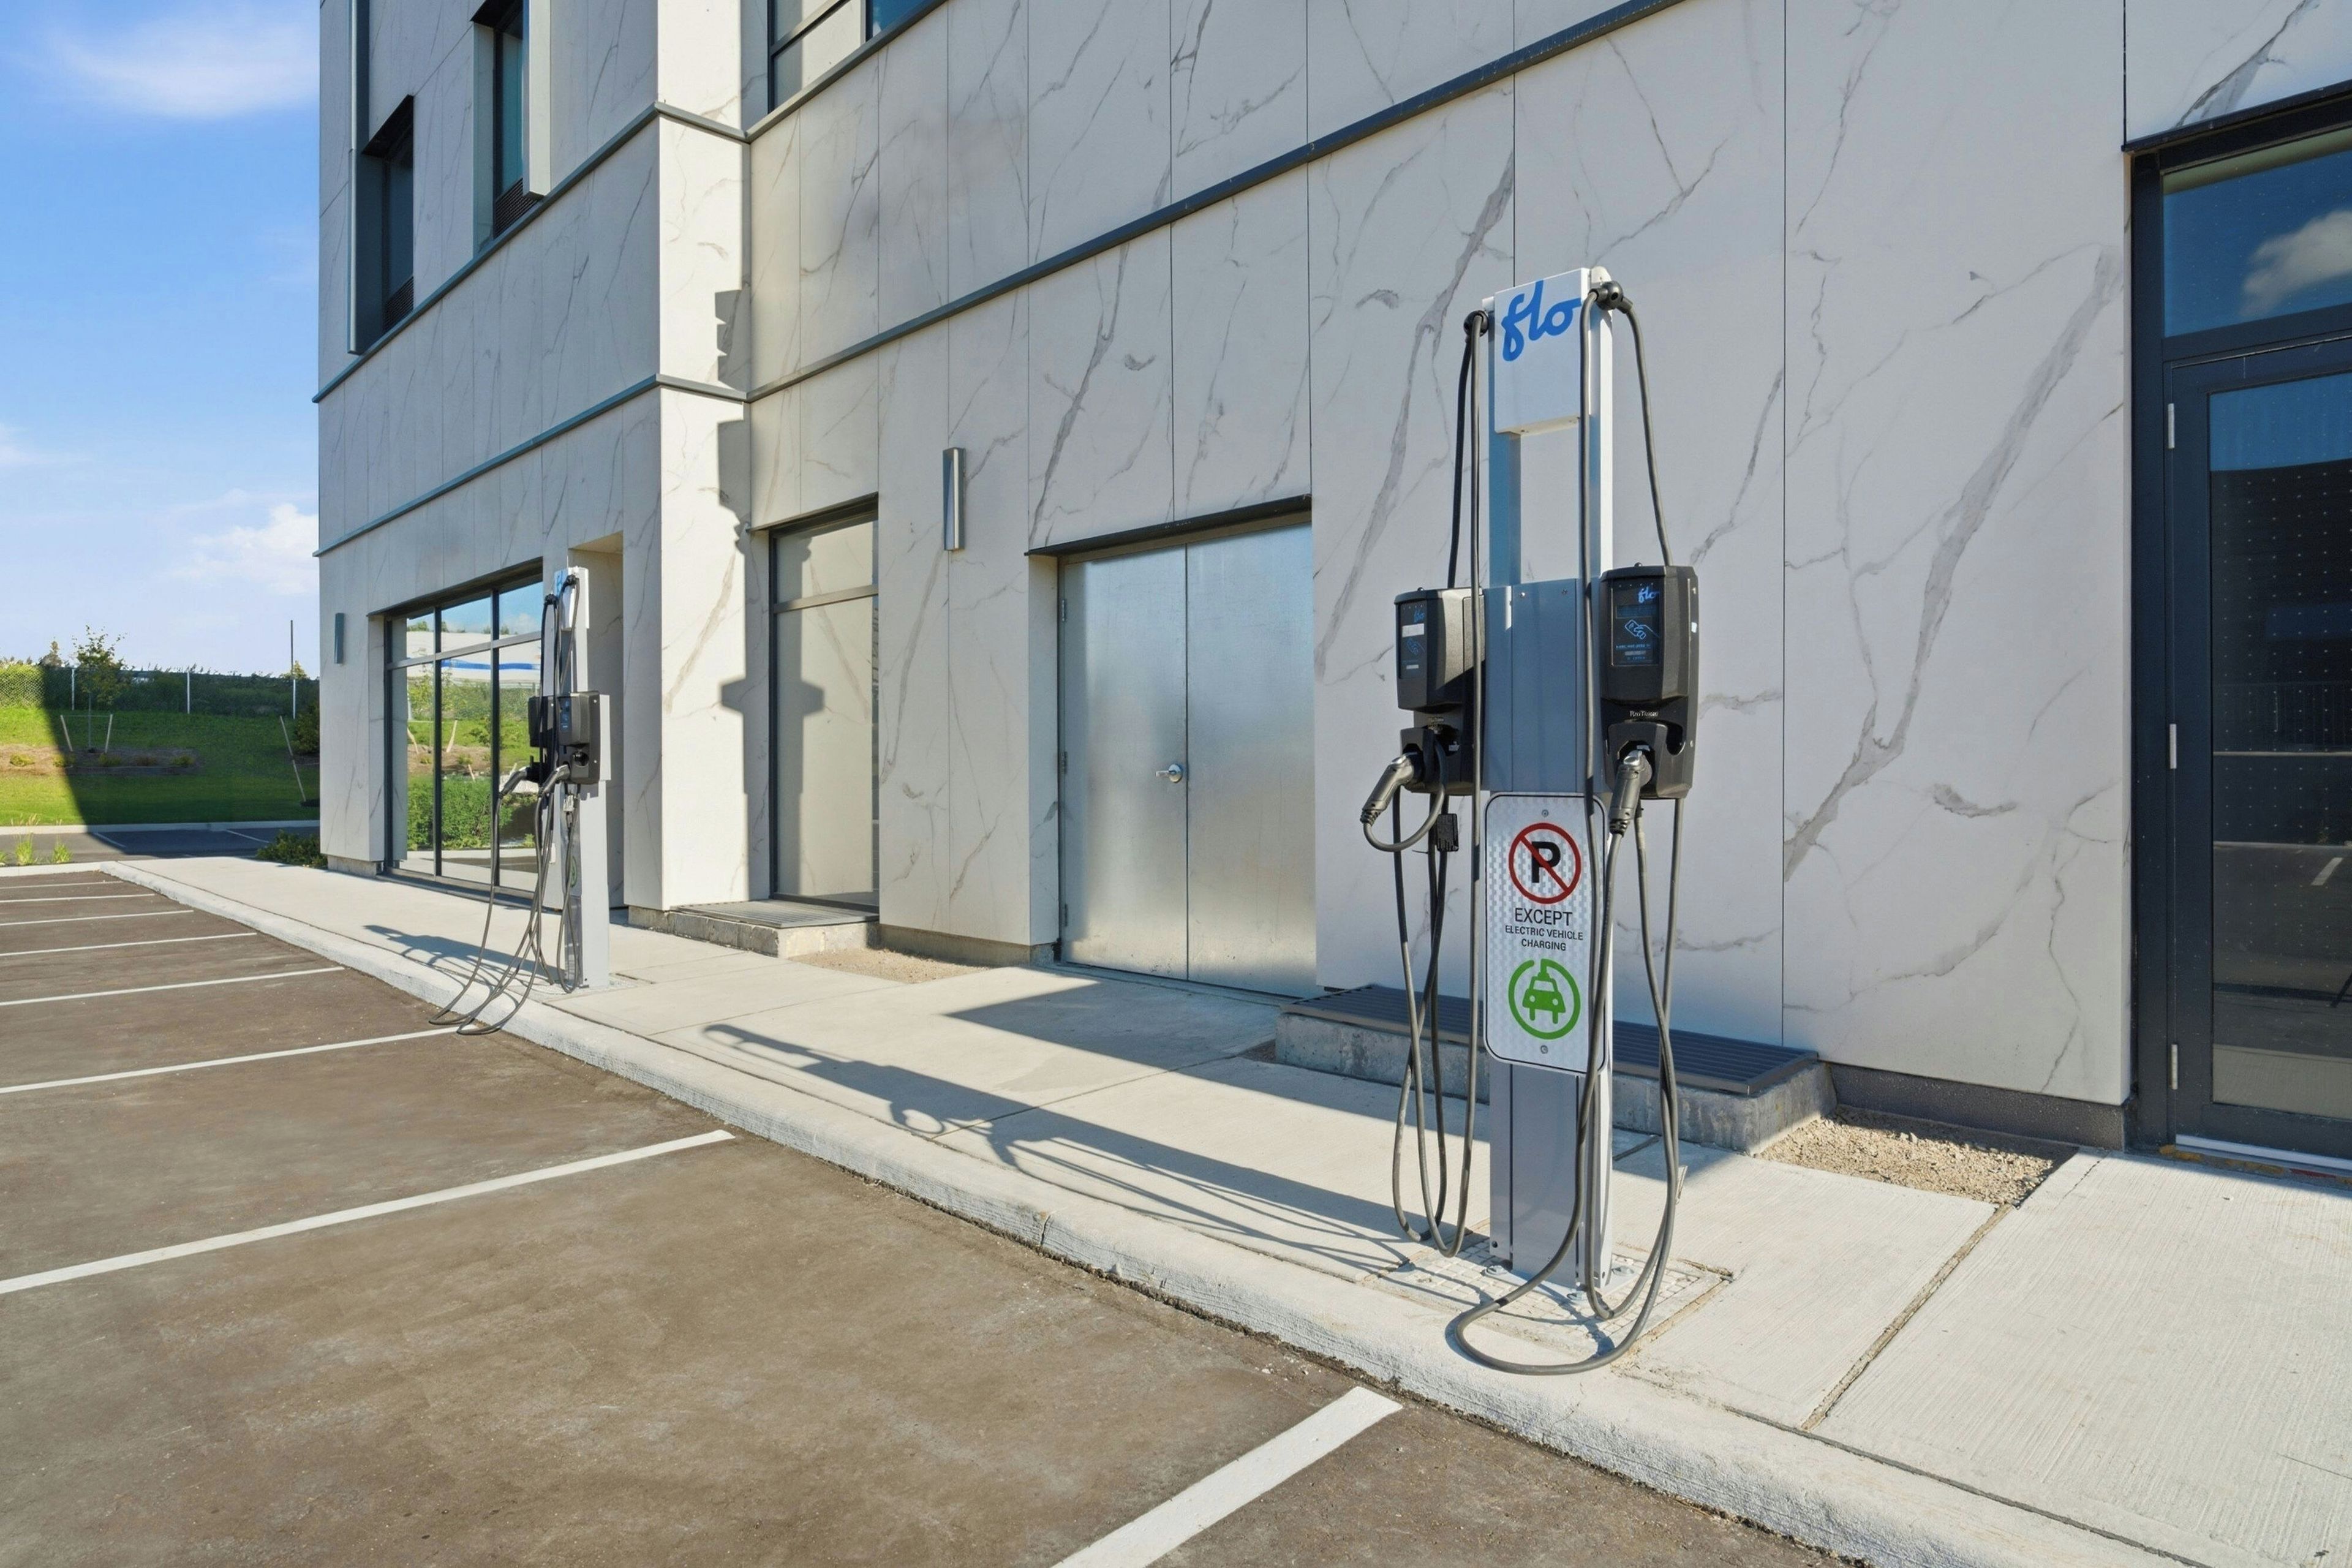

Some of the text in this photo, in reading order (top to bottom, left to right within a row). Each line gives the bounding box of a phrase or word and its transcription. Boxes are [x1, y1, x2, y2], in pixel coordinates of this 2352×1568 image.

[1501, 279, 1582, 362] flo
[1515, 907, 1572, 925] EXCEPT
[1505, 925, 1583, 940] ELECTRIC VEHICLE
[1521, 938, 1566, 951] CHARGING
